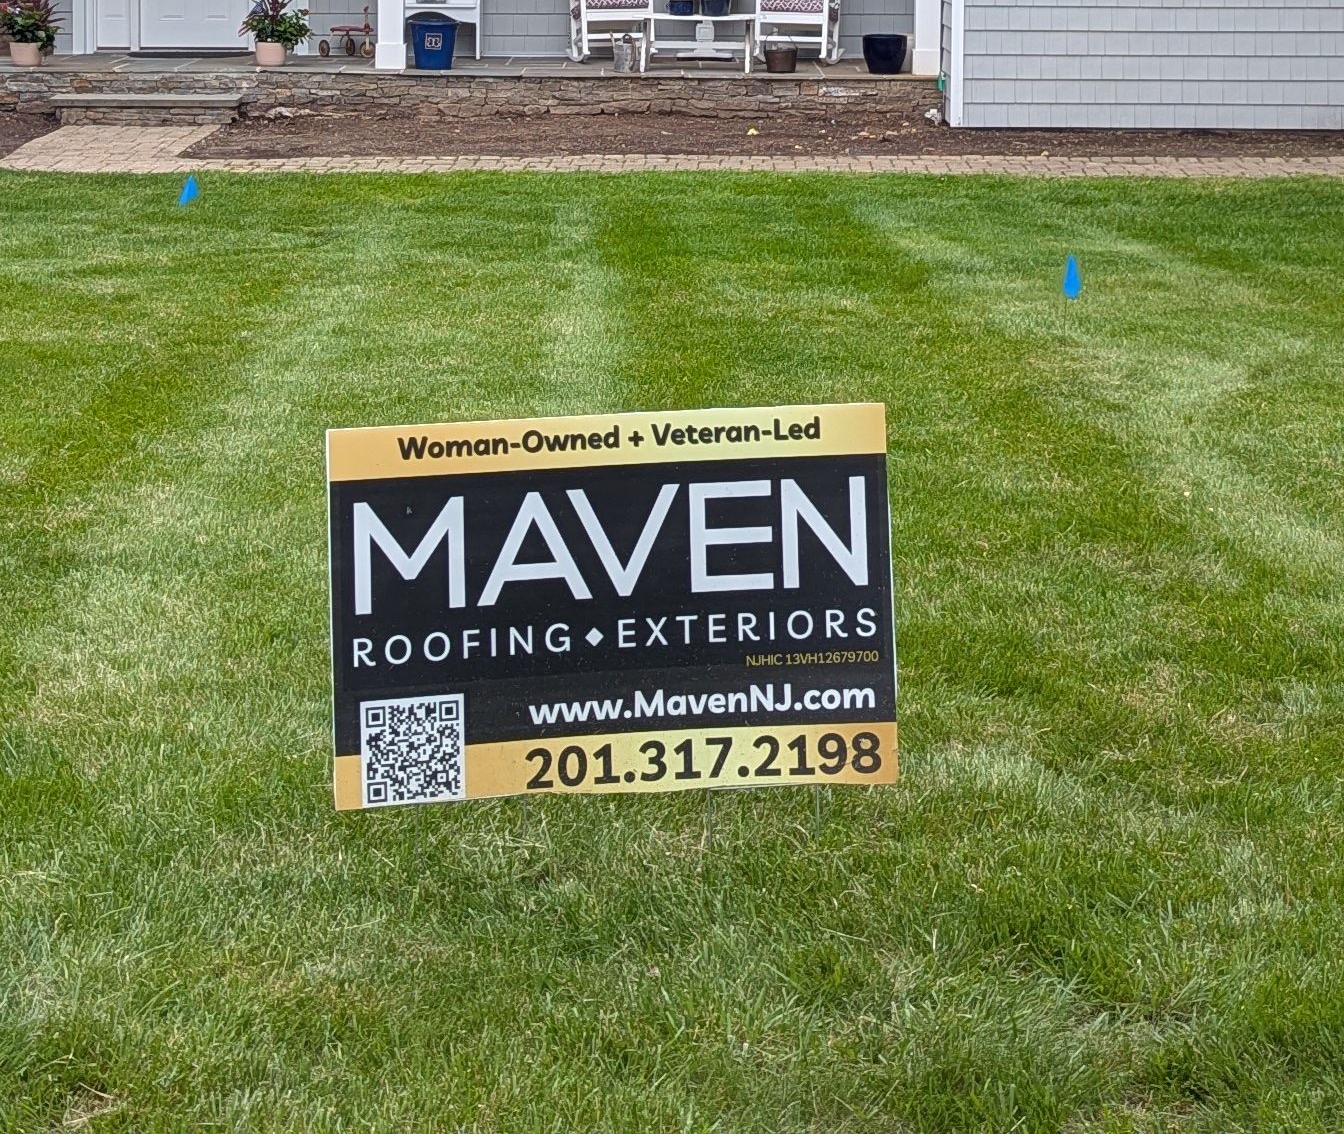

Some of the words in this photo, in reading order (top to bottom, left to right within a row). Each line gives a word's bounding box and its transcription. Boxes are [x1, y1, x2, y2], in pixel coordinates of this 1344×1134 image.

[397, 424, 620, 461] Woman-Owned
[627, 430, 645, 448] +
[651, 415, 821, 446] Veteran-Led
[353, 475, 869, 616] MAVEN
[352, 622, 571, 668] ROOFING
[617, 607, 877, 648] EXTERIORS
[745, 653, 784, 667] NJHIC
[785, 650, 880, 666] 13VH12679700
[528, 683, 876, 725] www.MavenNJ.com
[525, 731, 882, 790] 201.317.2198
